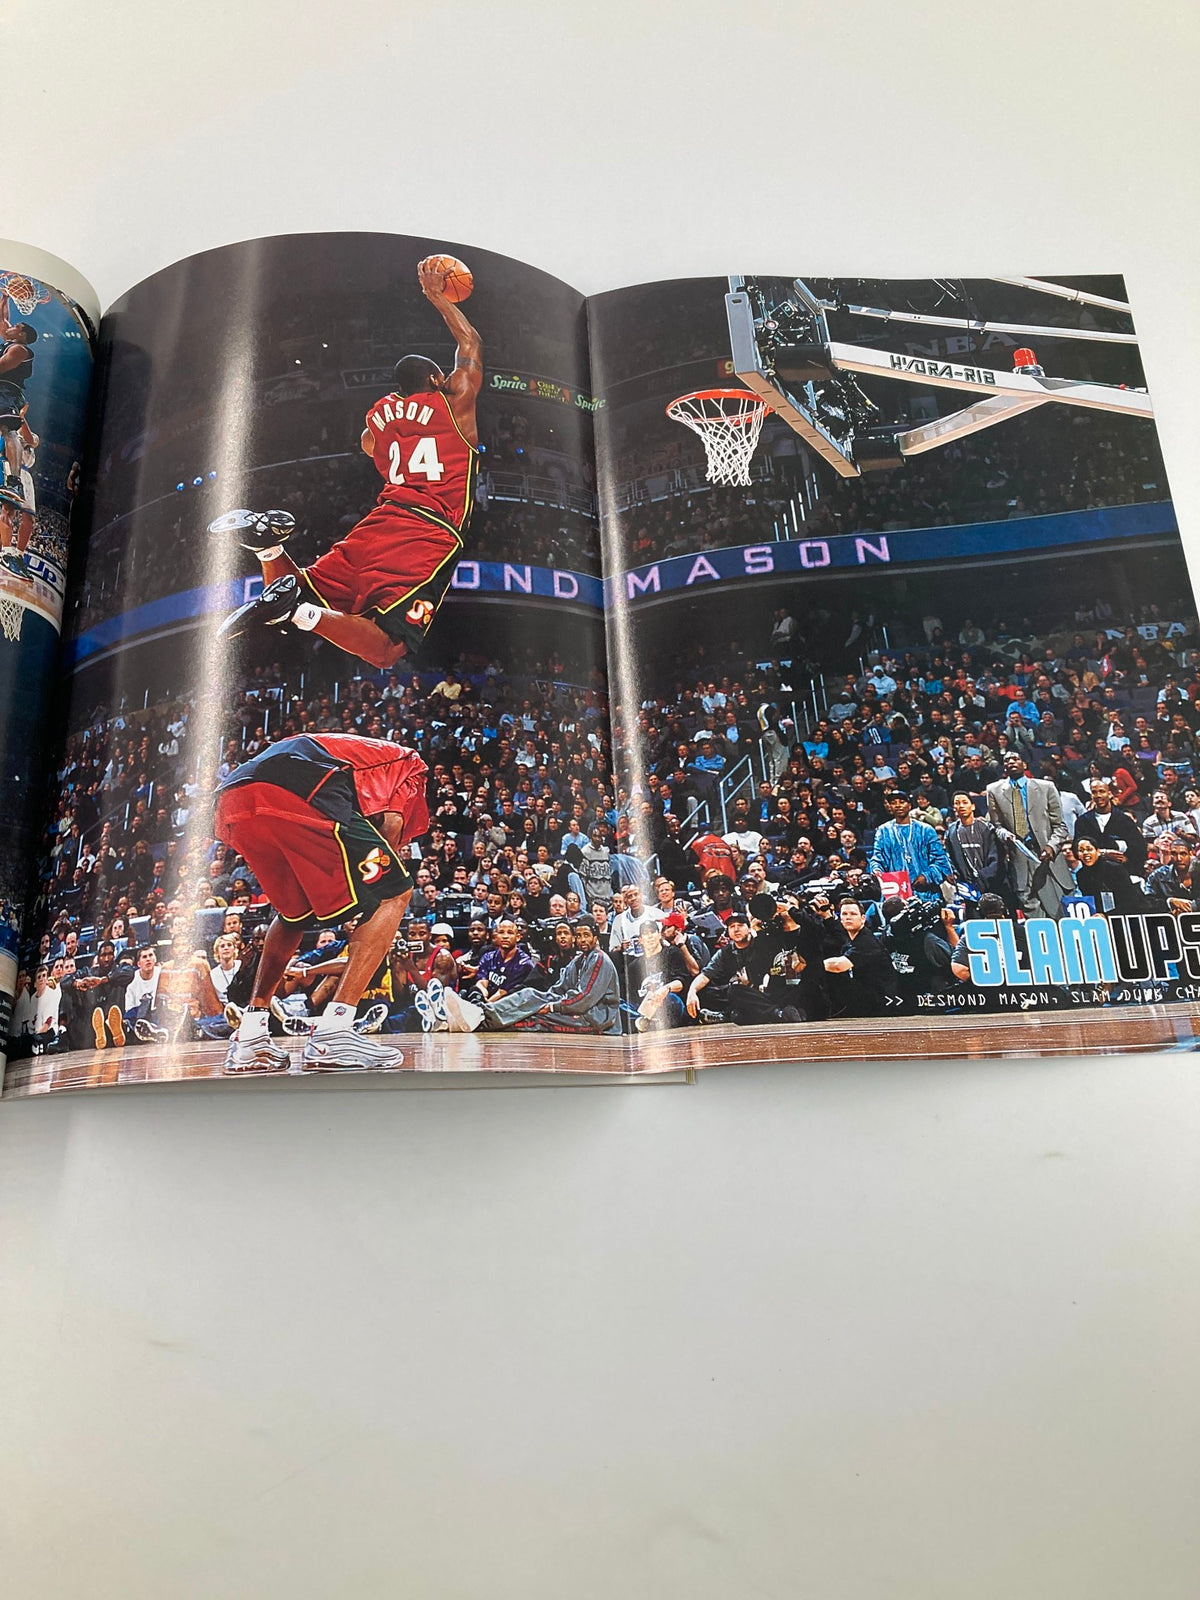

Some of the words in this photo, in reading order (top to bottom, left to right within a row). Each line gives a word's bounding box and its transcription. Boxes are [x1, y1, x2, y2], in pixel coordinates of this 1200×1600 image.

[904, 332, 1019, 356] NBA
[489, 374, 527, 391] Sprite
[889, 354, 996, 386] HYDRA-RIB
[371, 400, 435, 432] MASON
[574, 394, 606, 411] Sprite
[388, 437, 445, 485] 24
[625, 535, 891, 600] MASON
[916, 993, 986, 1007] DESMOND
[1070, 989, 1111, 1003] SLAM
